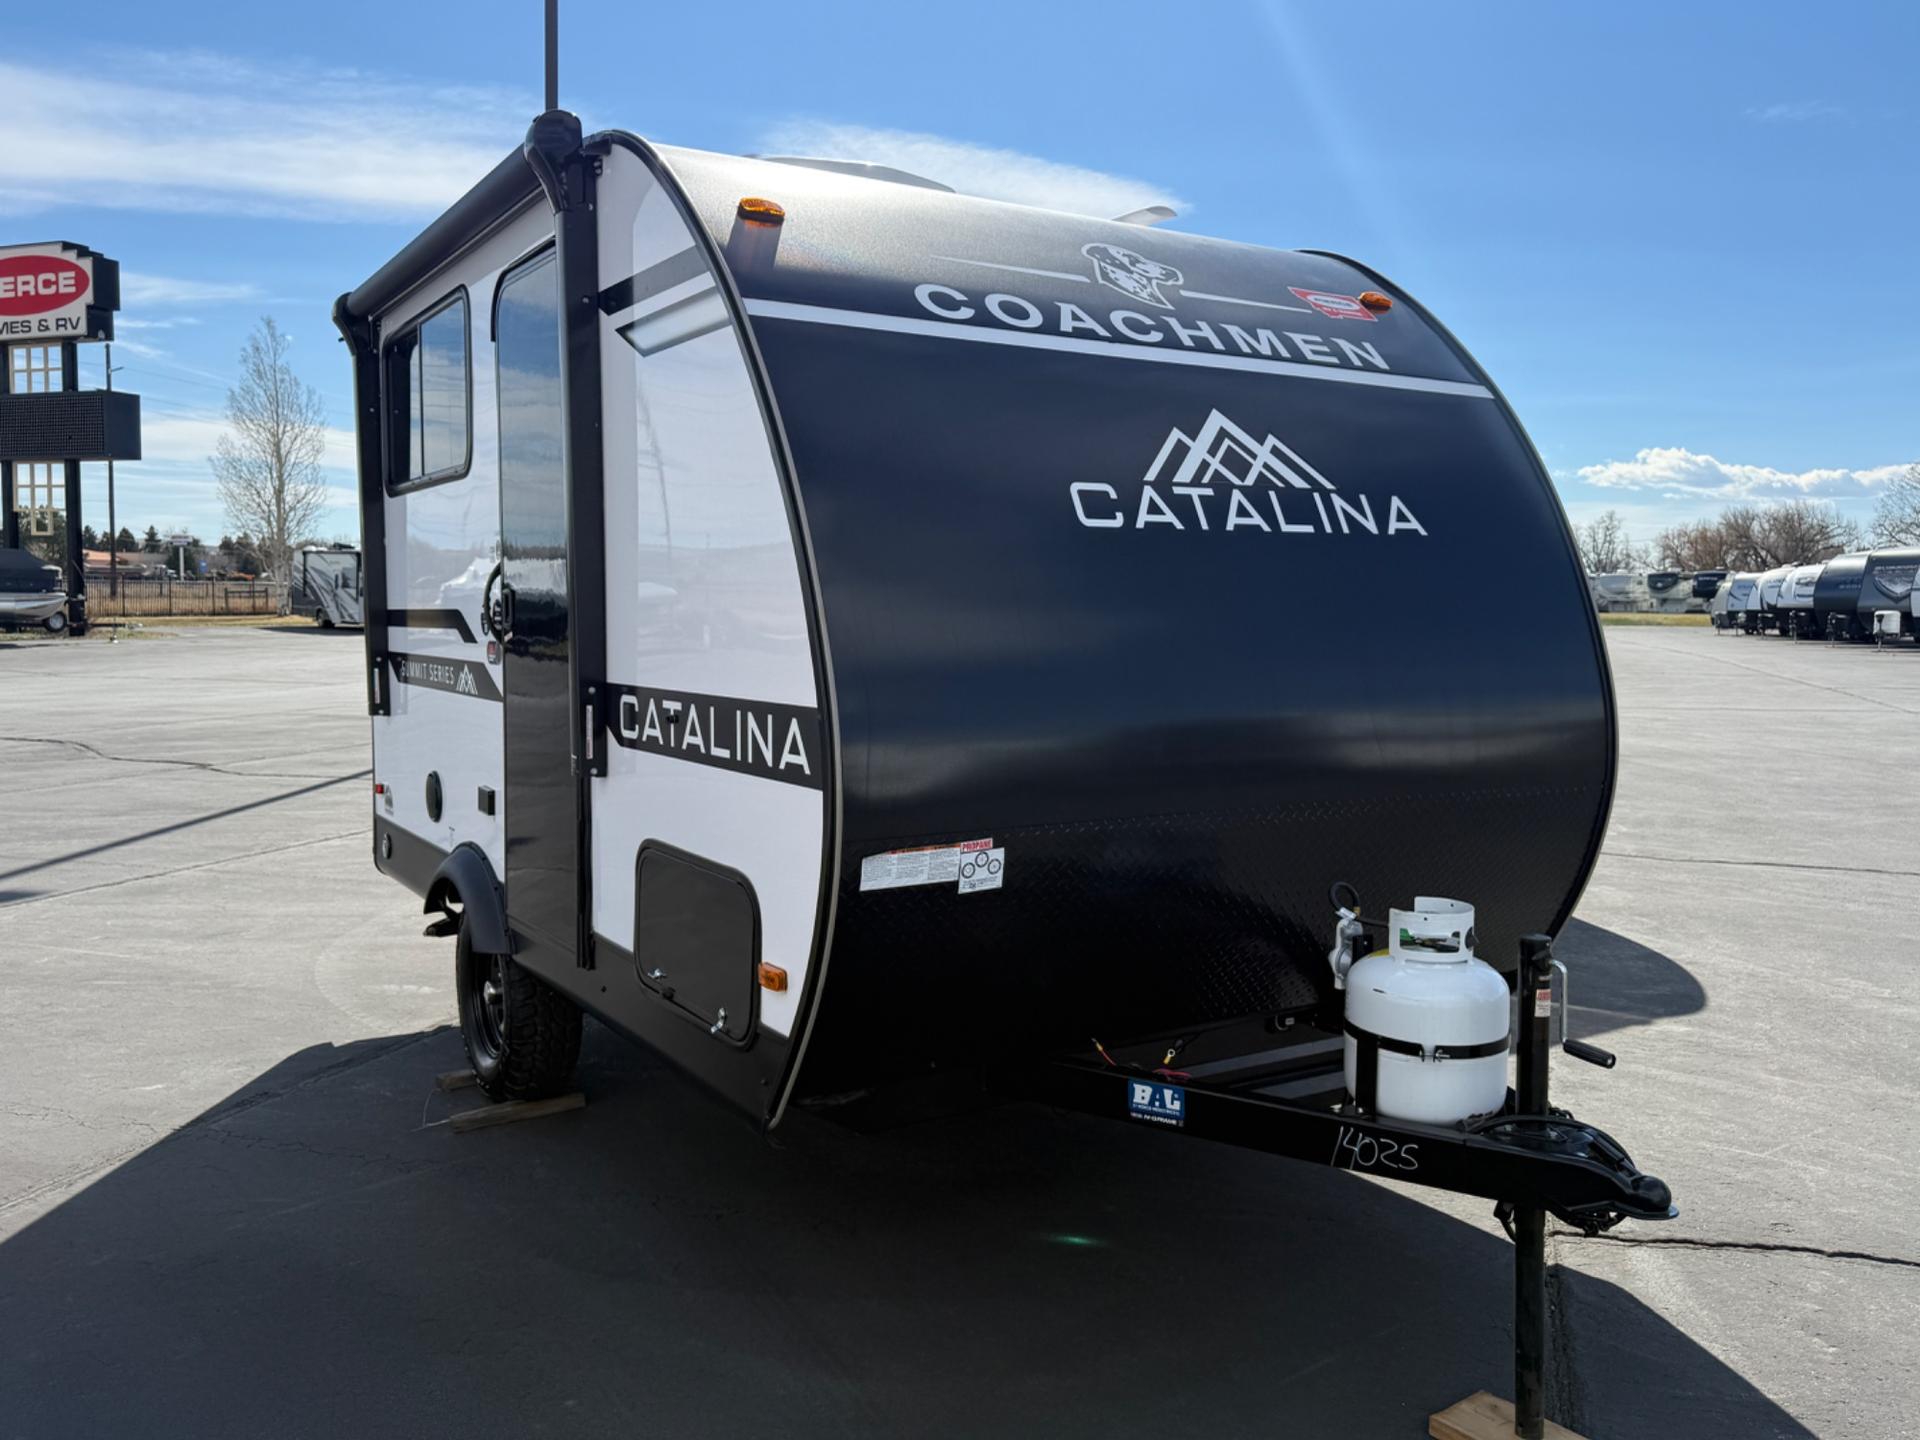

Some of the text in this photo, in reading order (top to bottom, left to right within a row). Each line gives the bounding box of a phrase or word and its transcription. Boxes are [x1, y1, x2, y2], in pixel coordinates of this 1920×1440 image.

[37, 318, 50, 332] &
[55, 316, 81, 332] RV
[914, 283, 1391, 370] COACHMEN
[1069, 481, 1429, 536] CATALINA
[401, 659, 455, 685] SUMMIT SERIES
[619, 693, 812, 775] CATALINA
